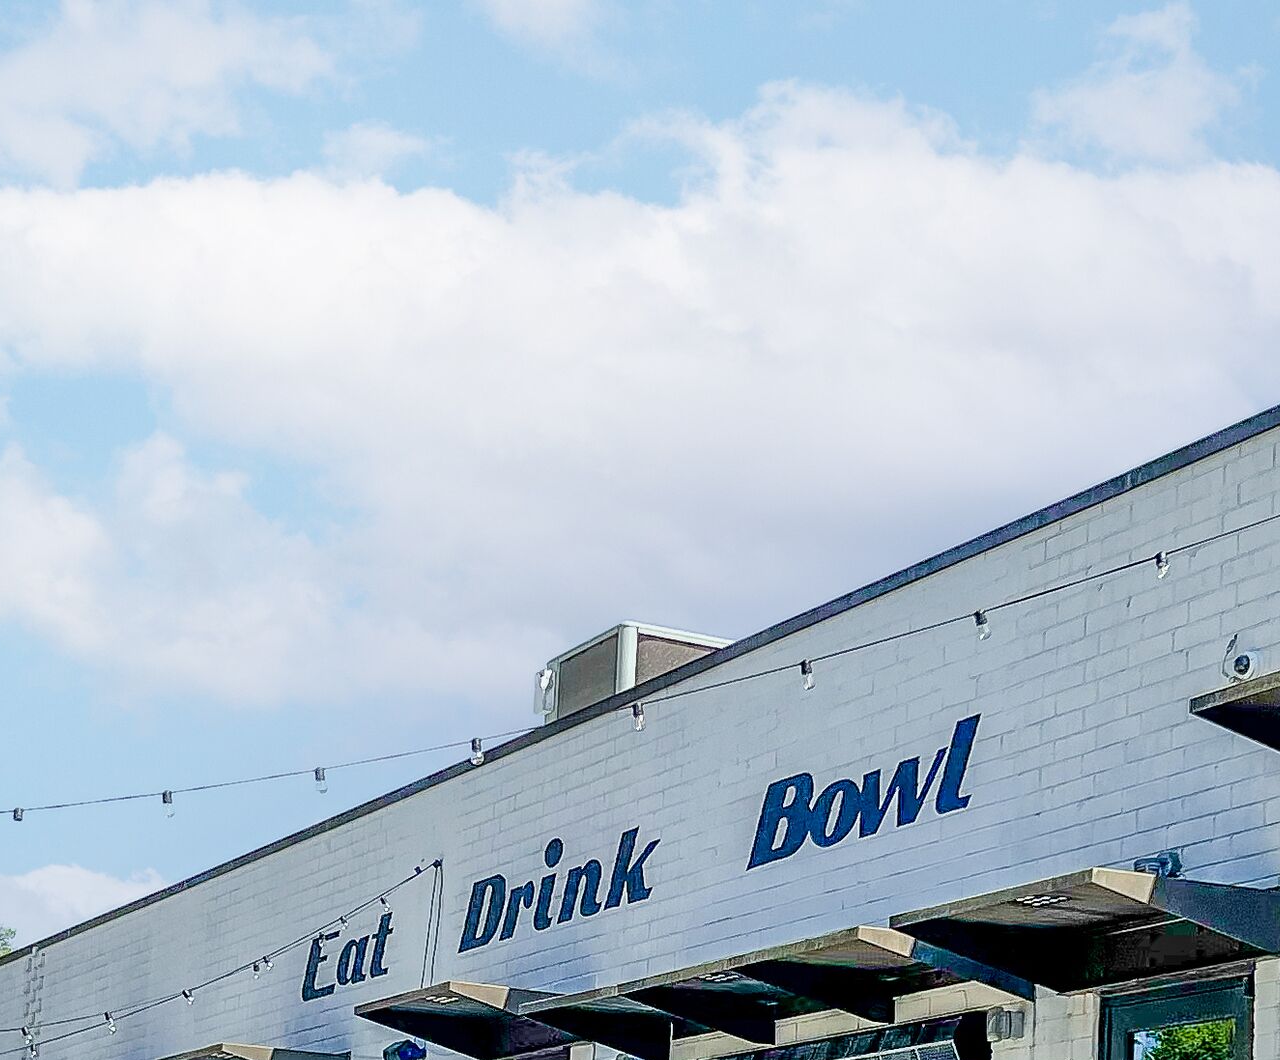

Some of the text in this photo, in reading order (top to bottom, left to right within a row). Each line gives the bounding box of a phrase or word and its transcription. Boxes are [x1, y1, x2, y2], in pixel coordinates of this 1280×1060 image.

[302, 713, 982, 1001] Eat Drink Bowl
